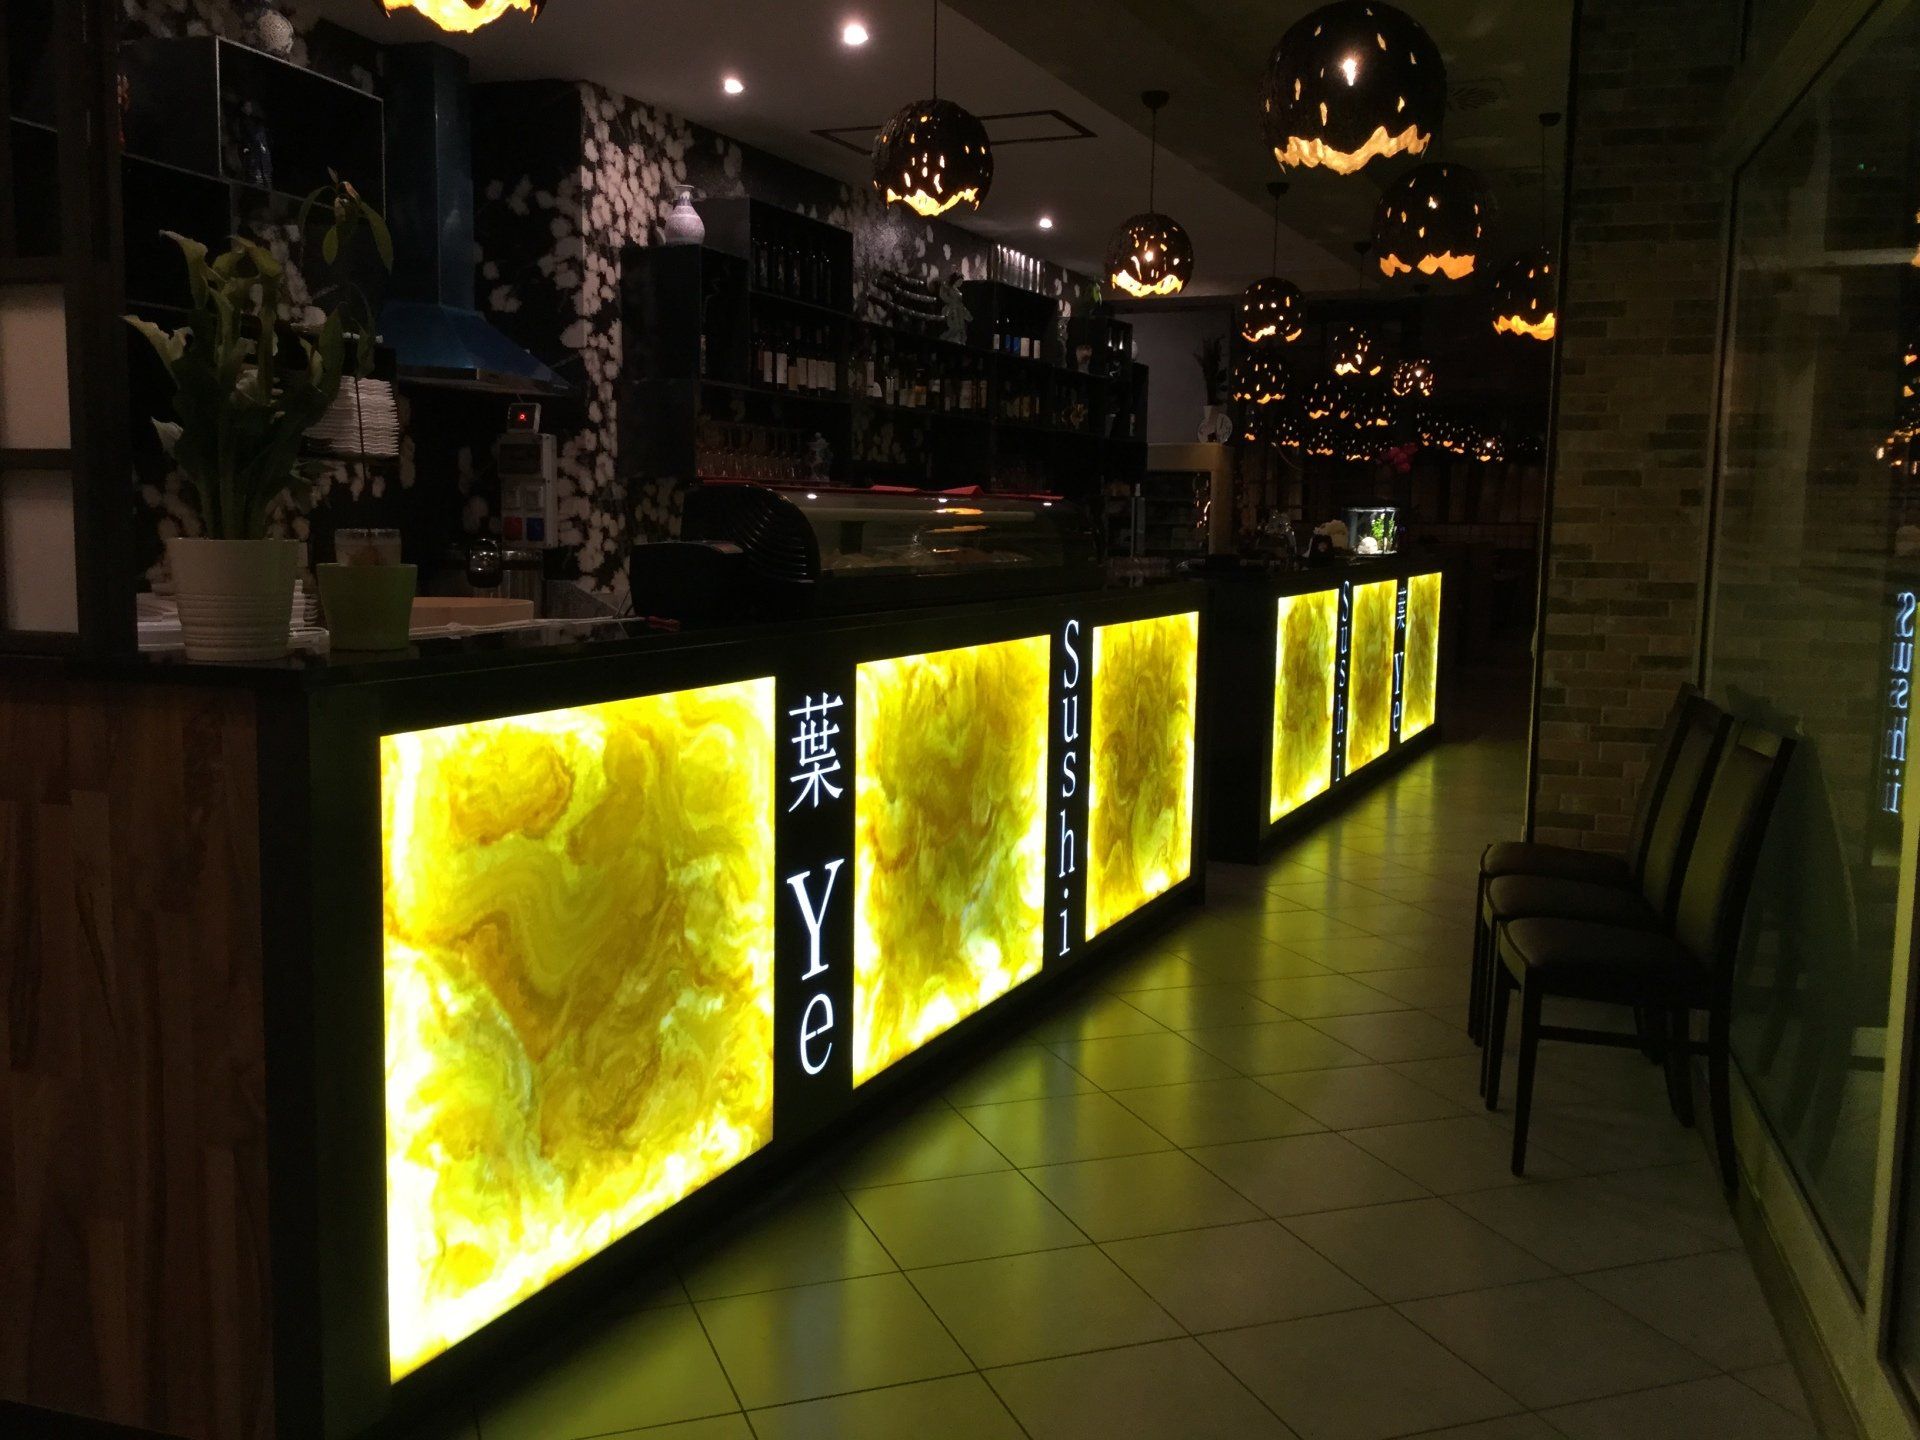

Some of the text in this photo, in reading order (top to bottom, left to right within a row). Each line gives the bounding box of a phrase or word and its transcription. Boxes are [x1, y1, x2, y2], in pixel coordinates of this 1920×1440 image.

[1058, 619, 1080, 957] Sushi
[1335, 580, 1350, 783] Sushi
[1393, 651, 1404, 732] Ye
[786, 691, 846, 1076] 葉 Ye
